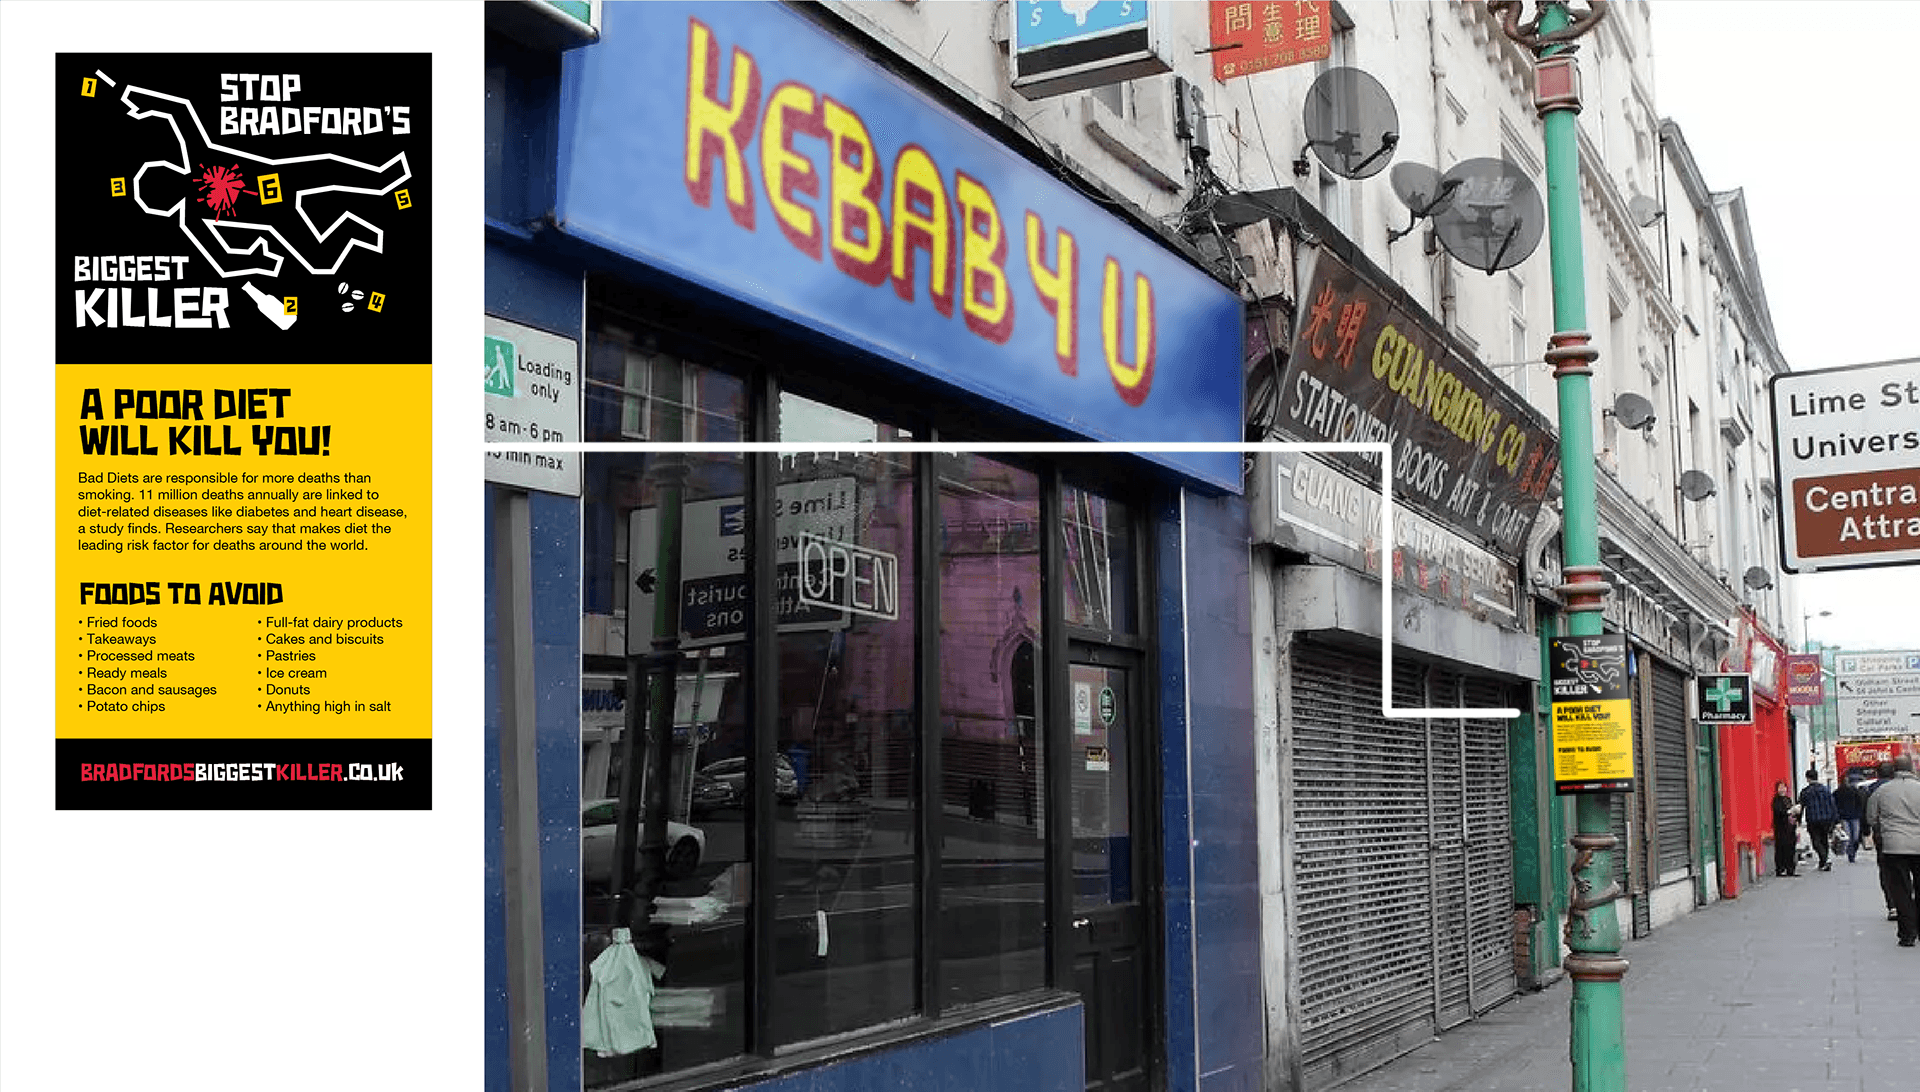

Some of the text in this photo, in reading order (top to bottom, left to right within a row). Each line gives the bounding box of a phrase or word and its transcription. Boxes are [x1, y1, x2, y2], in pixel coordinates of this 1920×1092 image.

[85, 80, 94, 94] 1
[220, 73, 302, 103] STOP
[220, 105, 411, 136] BRADFORD'S
[114, 181, 124, 194] 3
[261, 178, 280, 202] 6
[397, 193, 410, 206] 5
[684, 16, 1157, 407] KEBAB 4 U
[74, 255, 190, 282] BIGGEST
[75, 286, 231, 329] KILLER
[286, 300, 297, 313] 2
[371, 296, 382, 309] 4
[518, 353, 572, 386] Loading
[531, 383, 560, 403] only
[1372, 324, 1501, 454] GUANGMING
[1496, 423, 1527, 477] CO
[80, 387, 292, 421] A POOR DIET
[1790, 392, 1866, 417] Lime
[485, 413, 564, 443] 8 am 6 pm
[79, 424, 332, 457] WILL KILL YOU!
[1792, 430, 1920, 460] Univers
[535, 453, 564, 471] max
[78, 471, 371, 486] Bad Diets are responsible for more deaths than
[77, 488, 380, 504] smoking. 11 million deaths annually are linked to
[1396, 438, 1449, 501] BOOKS
[1446, 473, 1480, 517] ART
[1491, 500, 1531, 548] CRAFT
[1805, 482, 1918, 513] Centra
[1291, 460, 1359, 524] GUANG
[1365, 498, 1408, 547] MNG
[77, 505, 407, 519] diet-related diseases like diabetes and heart disease,
[77, 522, 392, 537] a study finds. Researchers say that makes diet the
[1839, 513, 1920, 542] Attra
[78, 538, 368, 554] leading risk factor for deaths around the world.
[803, 541, 895, 613] OPEN
[79, 581, 284, 607] FOODS TO AVOID
[87, 616, 158, 628] Fried foods
[266, 616, 403, 631] Full-fat dairy products
[86, 632, 157, 648] Takeaways
[265, 632, 385, 645] Cakes and biscuits
[87, 649, 196, 662] Processed meats
[266, 649, 317, 662] Pastries
[87, 666, 168, 681] Ready meals
[266, 666, 327, 679] Ice cream
[87, 683, 218, 699] Bacon and sausages
[266, 683, 311, 696] Donuts
[87, 700, 166, 715] Potato chips
[265, 700, 392, 715] Anything high in salt
[1702, 711, 1748, 721] Pharmacy
